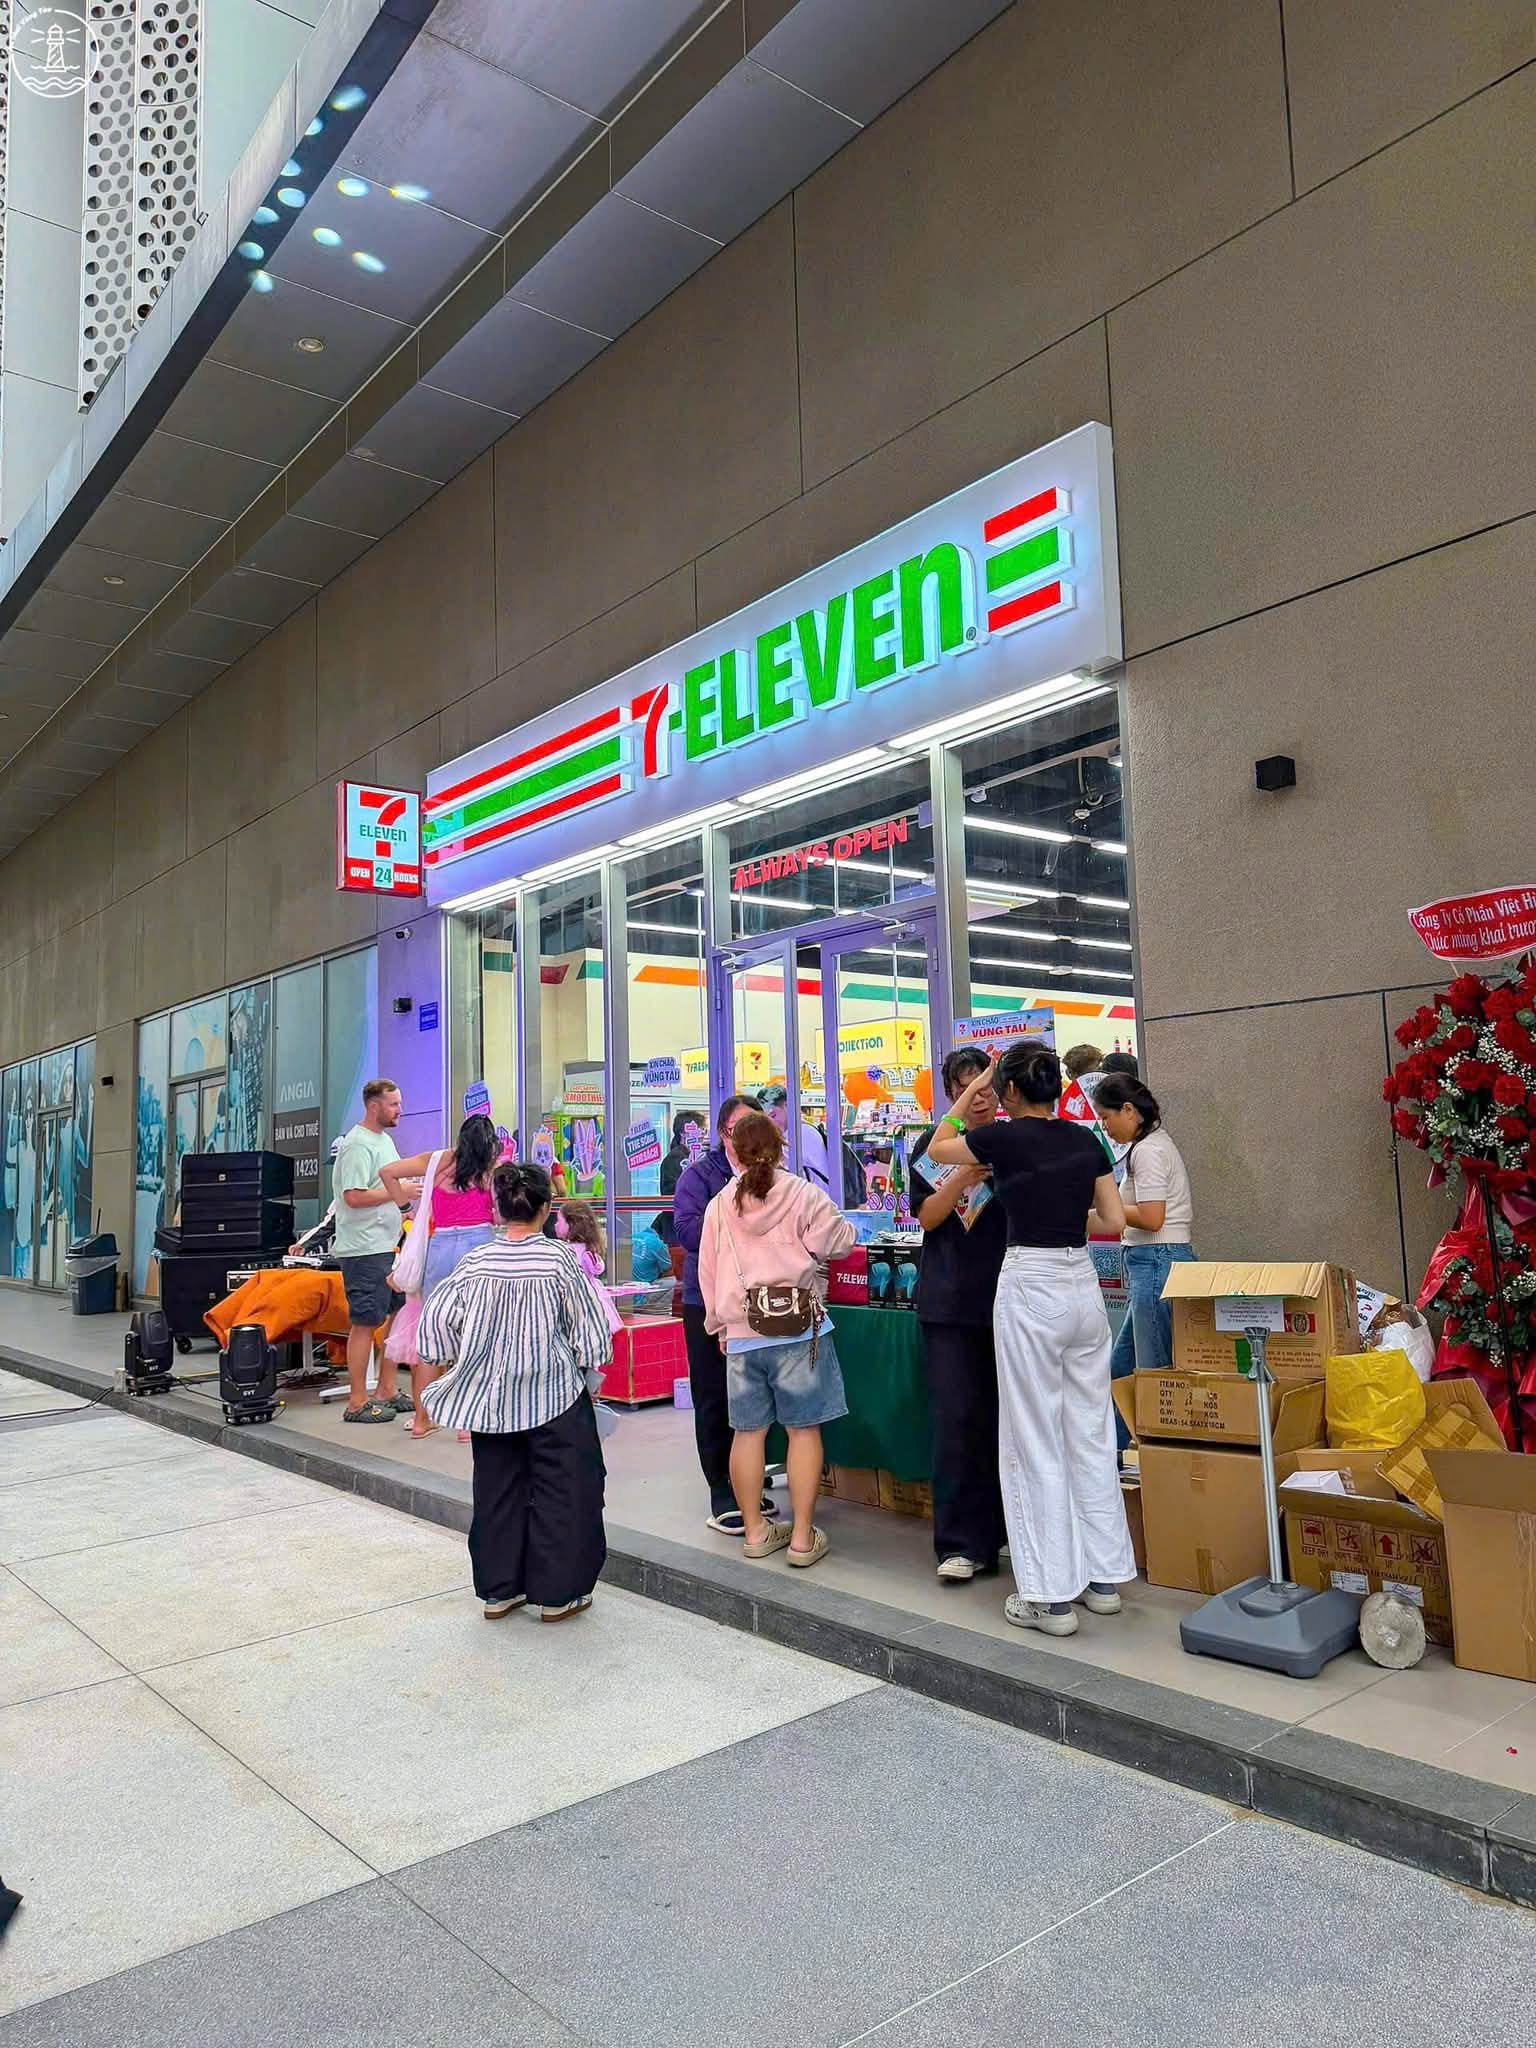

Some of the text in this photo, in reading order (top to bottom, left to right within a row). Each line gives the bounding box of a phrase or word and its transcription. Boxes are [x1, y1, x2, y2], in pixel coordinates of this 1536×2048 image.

[734, 816, 908, 891] ALWAYS OPEN
[375, 867, 392, 884] 24
[1412, 911, 1441, 930] Công
[1494, 898, 1522, 918] Việt
[1425, 931, 1450, 951] Chúc
